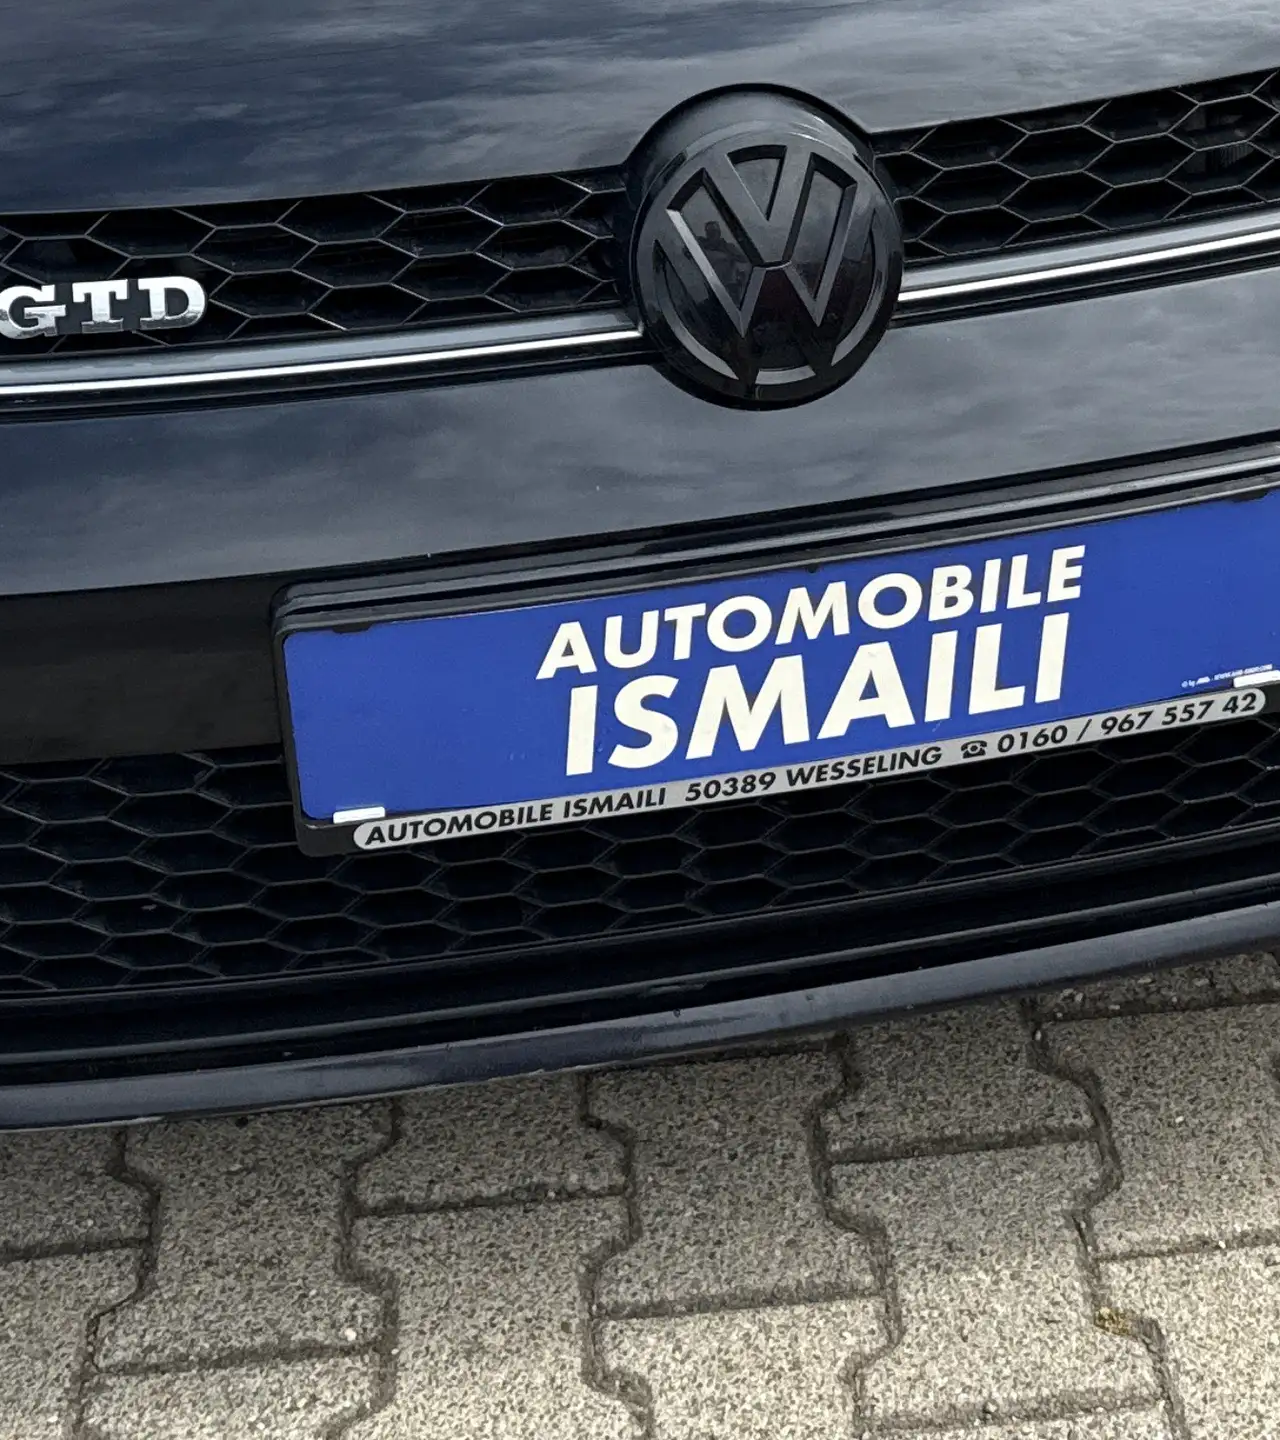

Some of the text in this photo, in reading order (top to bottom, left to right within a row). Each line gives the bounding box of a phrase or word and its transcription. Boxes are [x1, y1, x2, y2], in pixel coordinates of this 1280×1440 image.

[535, 545, 1086, 680] AUTOMOBILE
[364, 804, 553, 846] AUTOMOBILE
[563, 787, 667, 819] ISMAILI
[685, 771, 776, 802] 50389
[786, 746, 943, 786] WESSELING
[997, 725, 1067, 753] 0160
[1100, 711, 1154, 736] 967
[1161, 701, 1214, 726] 557
[1221, 693, 1258, 715] 42
[566, 612, 1069, 776] ISMAILI
